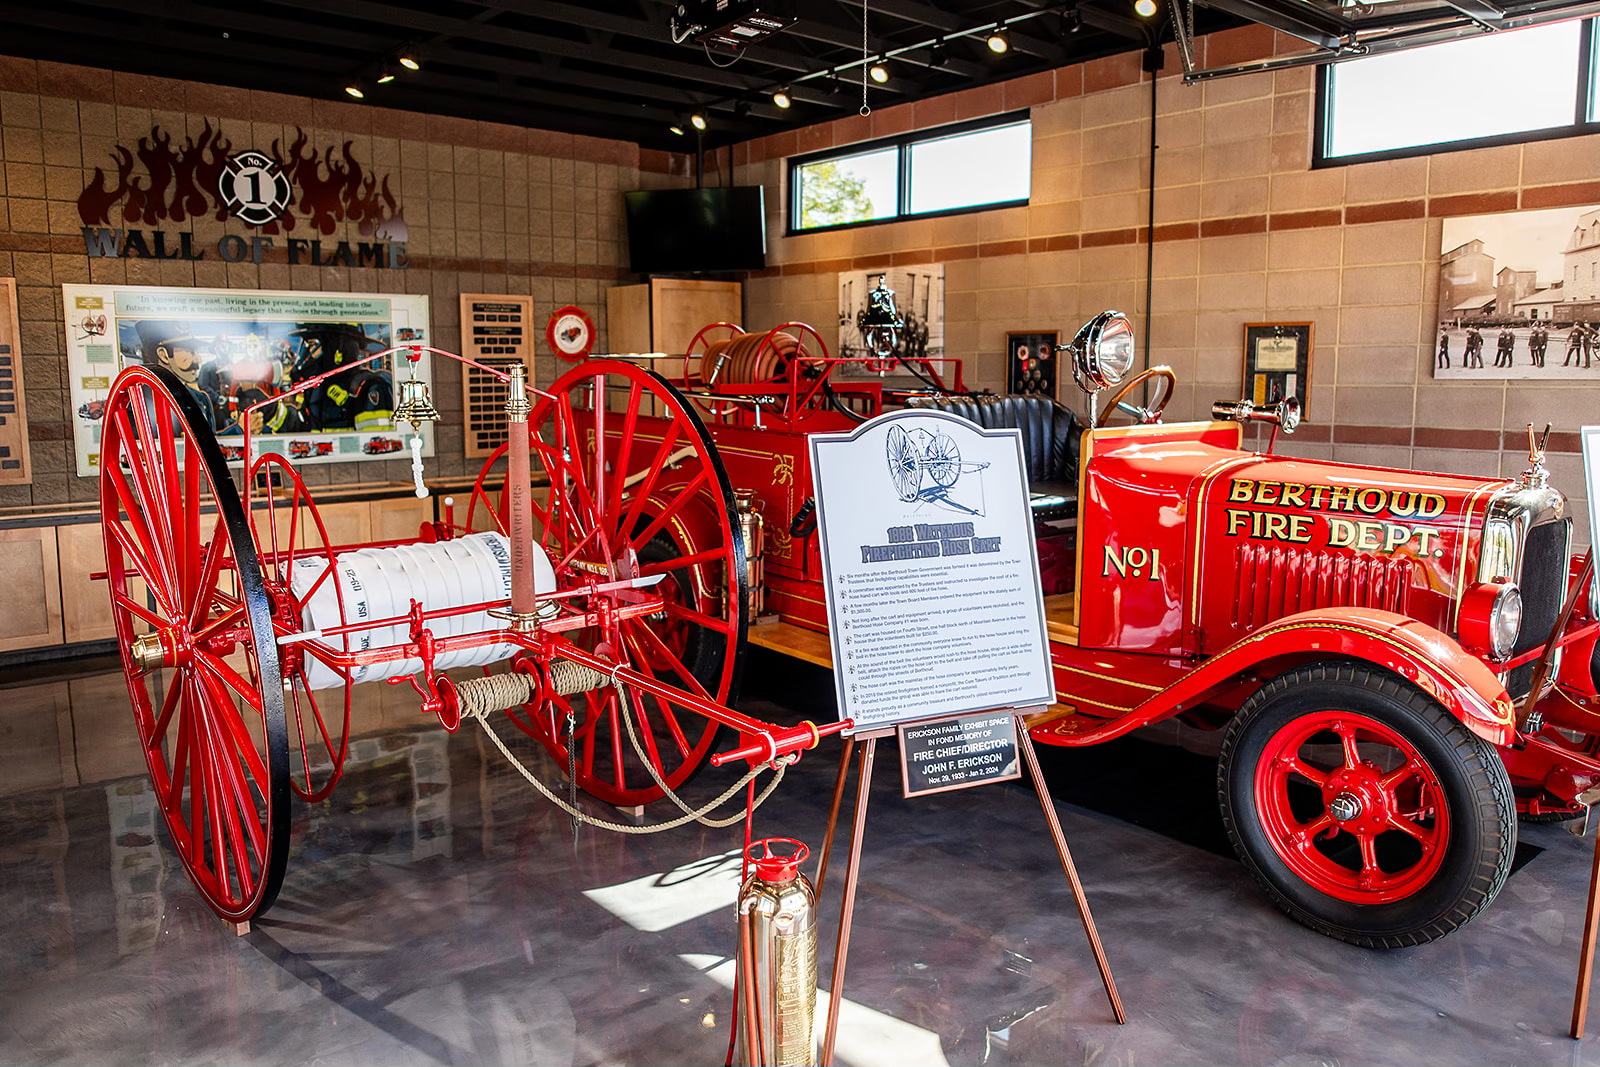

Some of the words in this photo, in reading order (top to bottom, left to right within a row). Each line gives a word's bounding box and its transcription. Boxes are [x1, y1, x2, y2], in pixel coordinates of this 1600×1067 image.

[246, 156, 262, 166] No.
[244, 170, 267, 204] 1
[80, 227, 204, 260] WALL
[218, 234, 274, 264] OF
[287, 238, 409, 270] FLAME
[197, 306, 240, 314] meaningful
[242, 306, 266, 316] legacy
[310, 308, 338, 316] through
[226, 298, 246, 306] living
[272, 300, 302, 308] present,
[319, 300, 344, 309] leading
[1228, 479, 1446, 519] BERTHOUD
[513, 484, 523, 572] UNDERWRITERS
[1226, 509, 1315, 544] FIRE
[1328, 518, 1444, 558] DEPT.
[860, 542, 940, 563] FIREFIGHTING
[940, 538, 971, 557] HOSE
[971, 536, 1001, 554] CART
[357, 601, 367, 617] USA
[908, 728, 941, 739] ERICKSON
[942, 725, 964, 734] FAMILY
[964, 720, 988, 730] EXHIBIT
[988, 717, 1009, 727] SPACE
[936, 736, 954, 744] FOND
[955, 731, 982, 741] MEMORY
[914, 750, 934, 762] FIRE
[936, 738, 1008, 758] CHIEF/DIRECTOR
[922, 762, 947, 775] JOHN
[949, 761, 956, 770] F.
[958, 753, 1002, 768] ERICKSON
